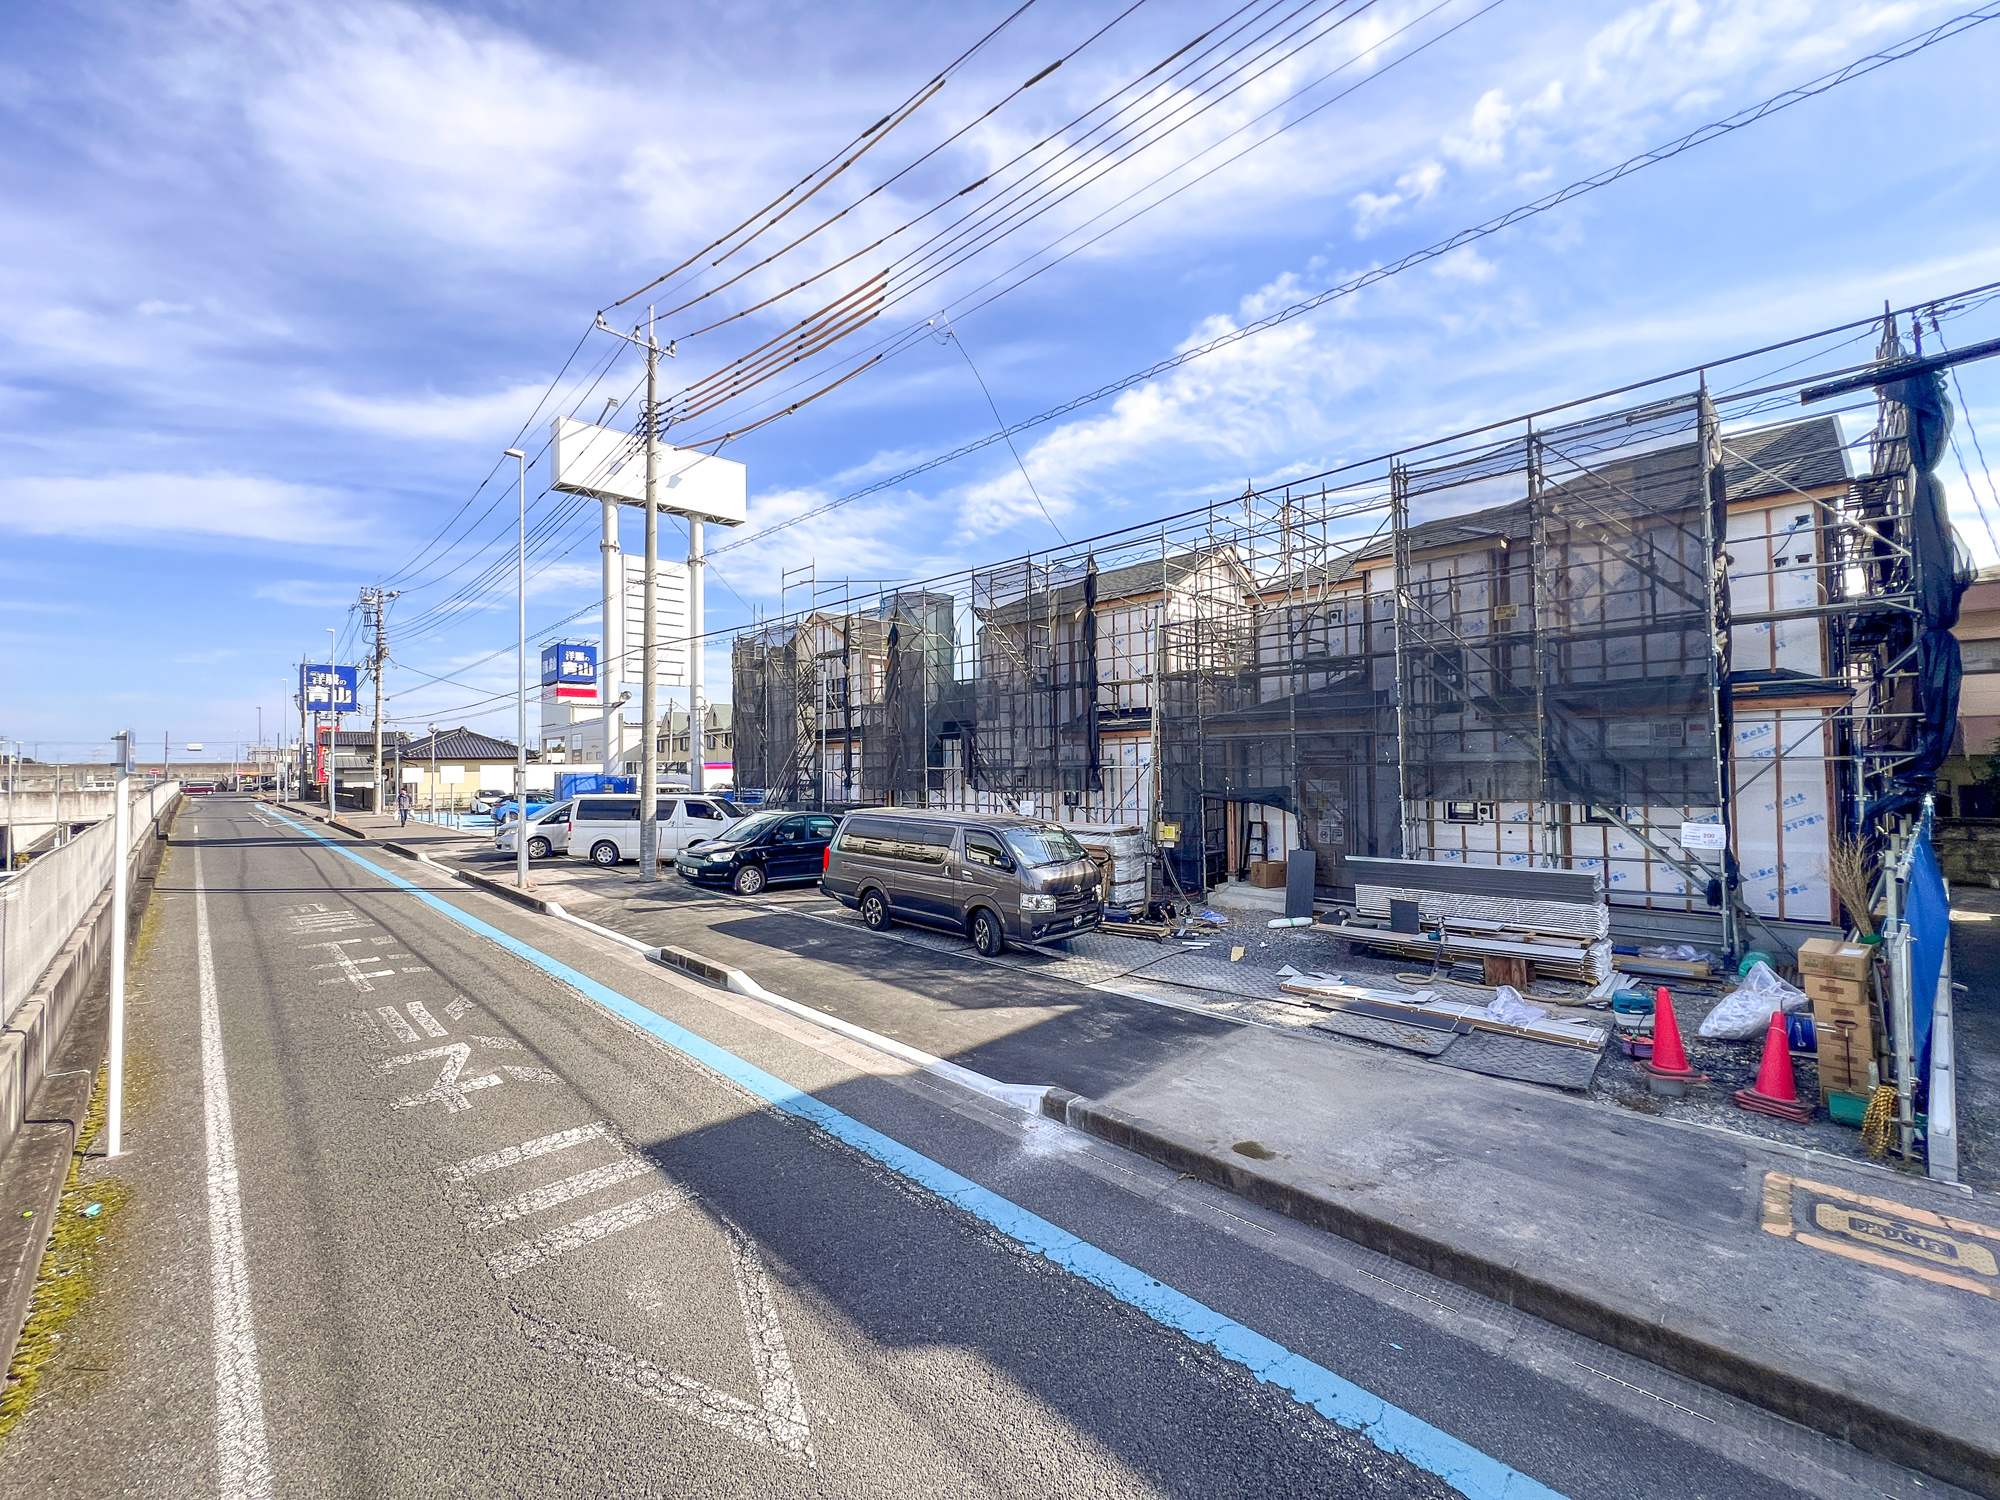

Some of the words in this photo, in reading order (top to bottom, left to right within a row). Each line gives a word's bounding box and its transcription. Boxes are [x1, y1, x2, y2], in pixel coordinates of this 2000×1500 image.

[565, 651, 591, 662] 洋服の
[561, 661, 594, 677] 青山
[309, 670, 347, 686] 洋服の
[306, 685, 352, 703] 青山
[1857, 1221, 1948, 1254] 消火栓
